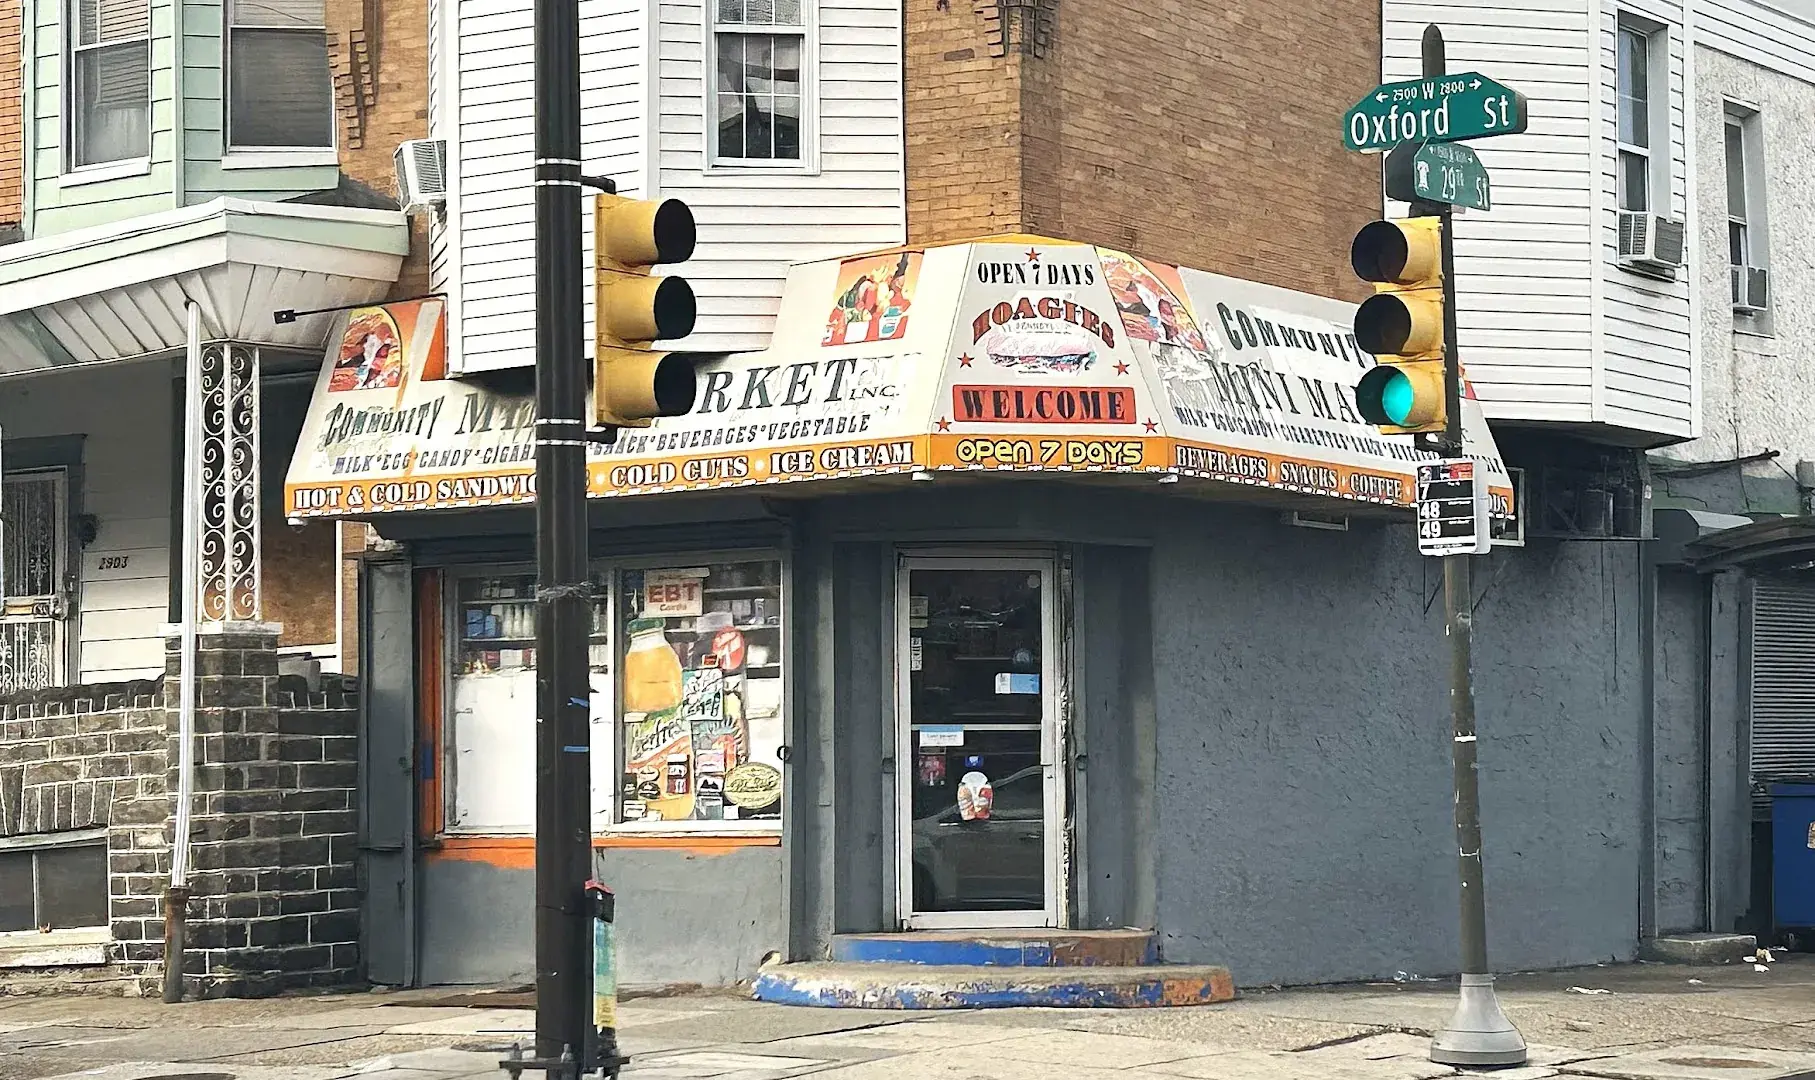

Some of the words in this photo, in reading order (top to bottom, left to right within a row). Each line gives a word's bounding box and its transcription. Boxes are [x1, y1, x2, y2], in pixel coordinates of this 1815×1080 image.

[1422, 82, 1435, 100] W
[1350, 96, 1449, 146] Oxford
[1483, 95, 1510, 128] St
[978, 263, 1026, 285] OPEN
[1032, 264, 1041, 285] 7
[1047, 264, 1094, 286] DAYS
[972, 297, 1115, 349] HOAGIES
[1216, 301, 1369, 369] COMMUNIT
[696, 358, 857, 414] RKET
[961, 390, 1125, 420] WELCOME
[324, 394, 446, 446] COMMUNITY
[768, 414, 870, 441] VEGETABLE
[610, 462, 678, 488] COLD
[682, 456, 750, 483] CUTS
[770, 450, 815, 475] ICE
[819, 442, 915, 469] CREAM
[1040, 440, 1061, 463] 7
[1175, 445, 1268, 479] BEVERAGES
[1280, 461, 1338, 489] SNACKS
[1350, 473, 1402, 500] COFFEE
[294, 486, 342, 509] HOT
[347, 488, 365, 506] &
[370, 482, 432, 503] COLD
[1420, 483, 1430, 500] 7
[1420, 501, 1440, 519] 48
[1421, 521, 1441, 538] 49
[98, 556, 129, 570] 2903
[648, 582, 700, 603] EBT
